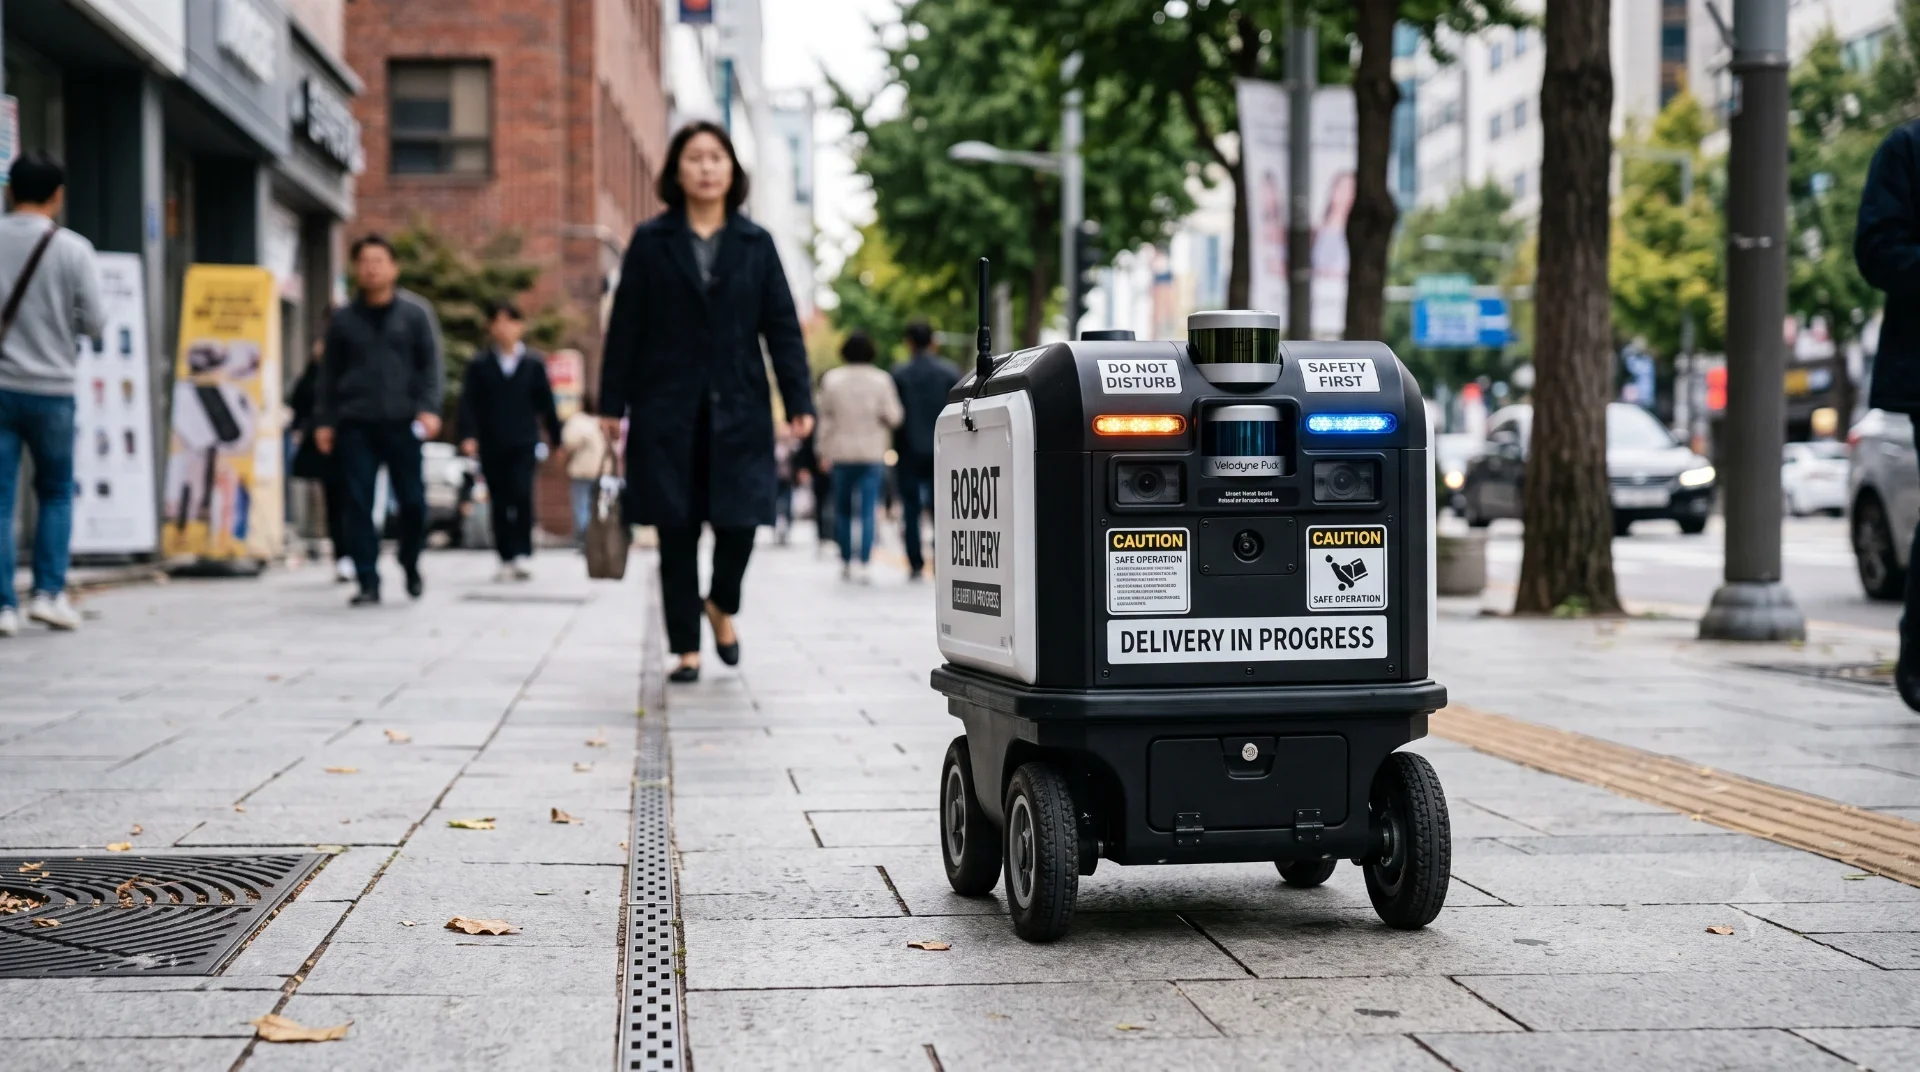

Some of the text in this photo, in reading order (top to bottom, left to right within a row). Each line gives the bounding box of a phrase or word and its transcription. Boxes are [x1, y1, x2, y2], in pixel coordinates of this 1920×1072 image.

[1108, 363, 1168, 374] DO NOT
[1308, 362, 1366, 373] SAFETY
[1106, 377, 1176, 388] DISTURB
[1319, 375, 1362, 387] FIRST
[1214, 460, 1259, 472] Velodyne
[951, 466, 1000, 520] ROBOT
[1113, 533, 1183, 549] CAUTION
[1312, 530, 1381, 545] CAUTION
[951, 530, 1001, 569] DELIVERY
[1114, 555, 1182, 564] SAFE OPERATION
[1313, 594, 1381, 603] SAFE OPERATION
[1120, 625, 1374, 653] DELIVERY IN PROGRESS
